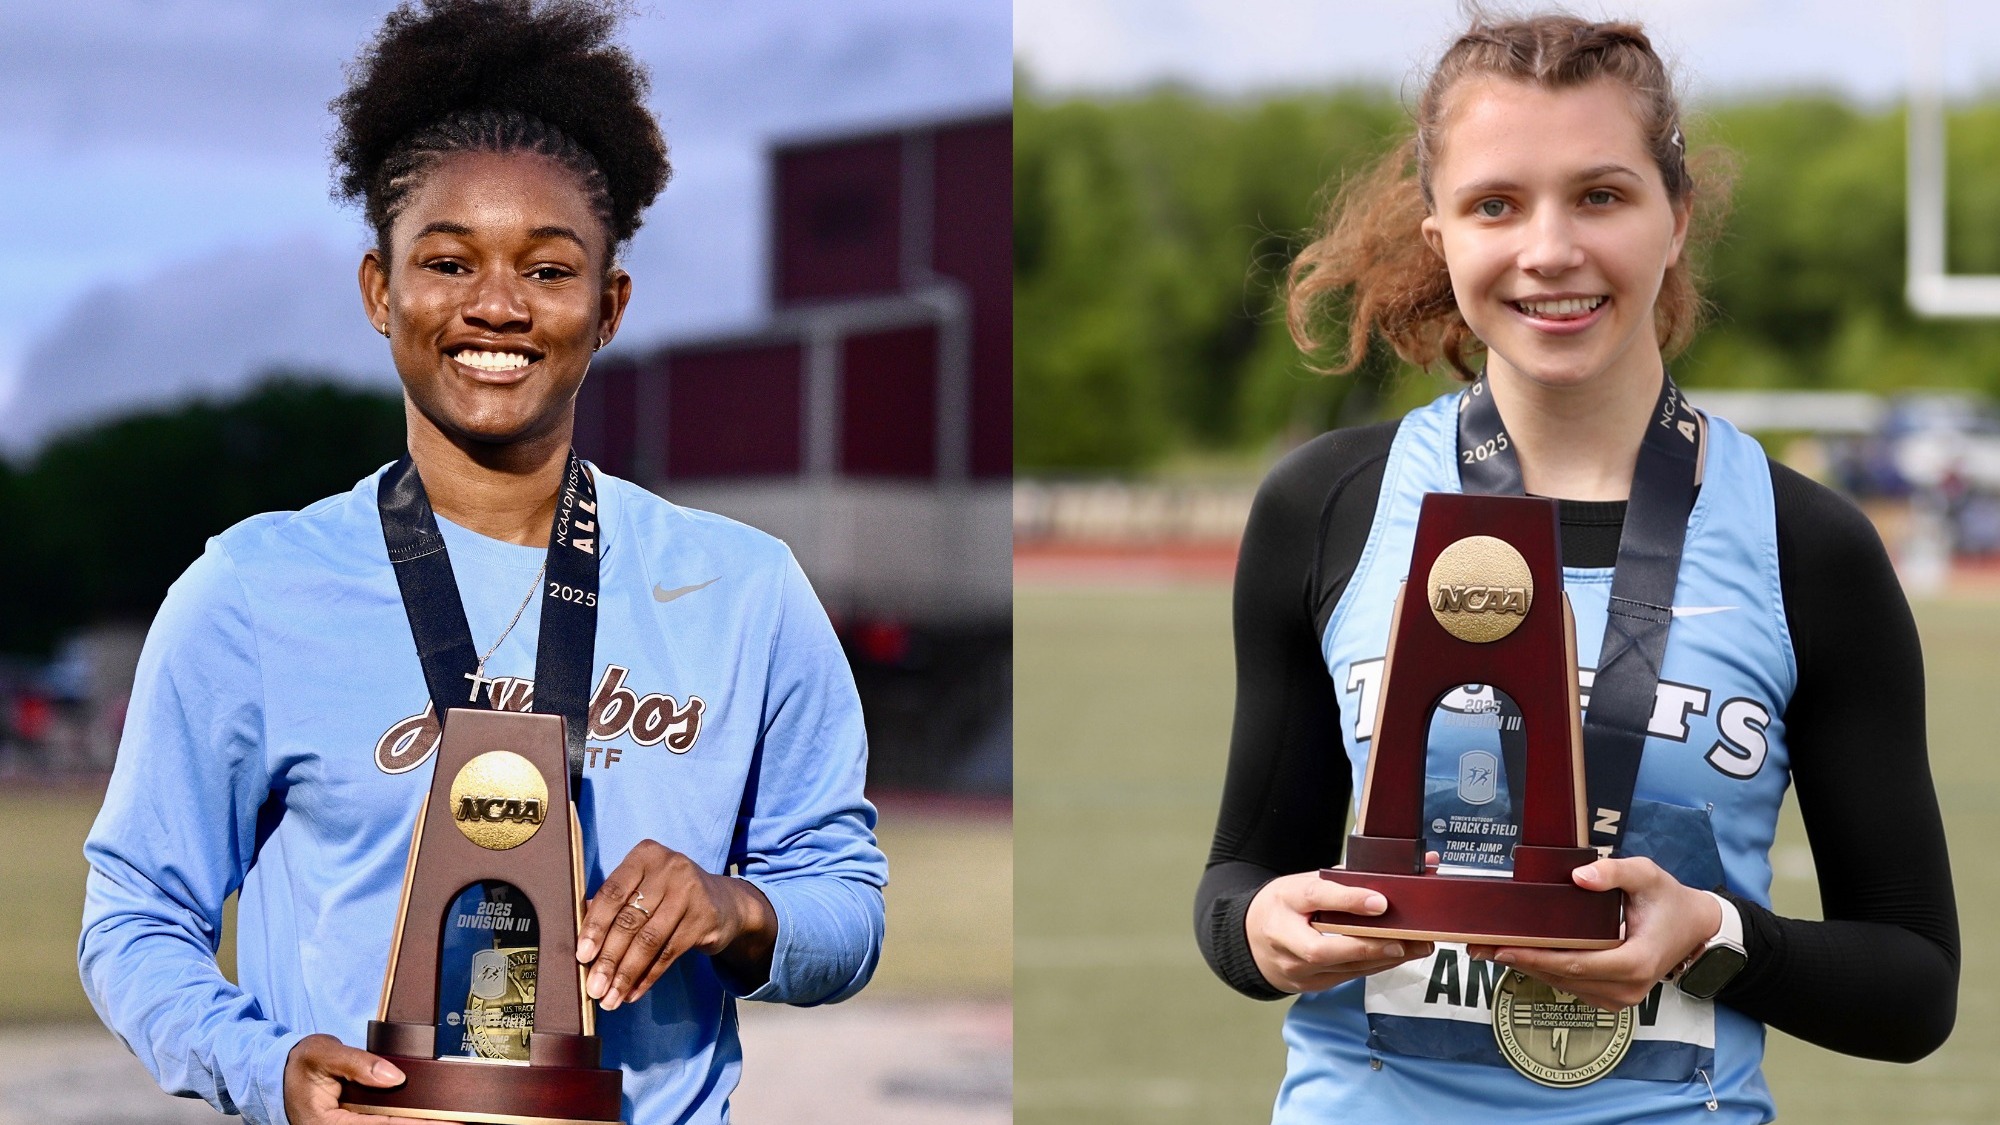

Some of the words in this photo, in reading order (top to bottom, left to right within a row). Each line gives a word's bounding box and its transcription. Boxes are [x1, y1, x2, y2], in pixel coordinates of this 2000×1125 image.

[1462, 432, 1508, 464] 2025
[557, 508, 571, 547] NCAA
[549, 582, 597, 608] 2025
[1435, 584, 1528, 616] NCAA
[1463, 699, 1502, 714] 2025
[1506, 716, 1522, 731] III
[457, 794, 542, 824] NCAA
[1449, 821, 1481, 834] TRACK
[1481, 823, 1490, 835] &
[1490, 823, 1518, 837] FIELD
[1446, 840, 1476, 851] TRIPLE
[1476, 842, 1503, 853] JUMP
[1442, 851, 1477, 863] FOURTH
[1477, 853, 1506, 865] PLACE
[477, 901, 513, 917] 2025
[457, 914, 514, 931] DIVISION
[516, 918, 531, 932] III
[1500, 998, 1509, 1026] NCAA
[1546, 1003, 1569, 1013] TRACK
[1569, 1004, 1576, 1012] &
[1577, 1004, 1596, 1013] FIELD
[1541, 1012, 1563, 1020] CROSS
[1564, 1012, 1596, 1021] COUNTRY
[1619, 1006, 1628, 1030] FIEL
[1617, 1032, 1626, 1040] &
[1502, 1029, 1532, 1069] DIVISION
[1597, 1041, 1621, 1068] TRACK
[1532, 1064, 1543, 1075] III
[1544, 1065, 1596, 1080] OUTDOOR
